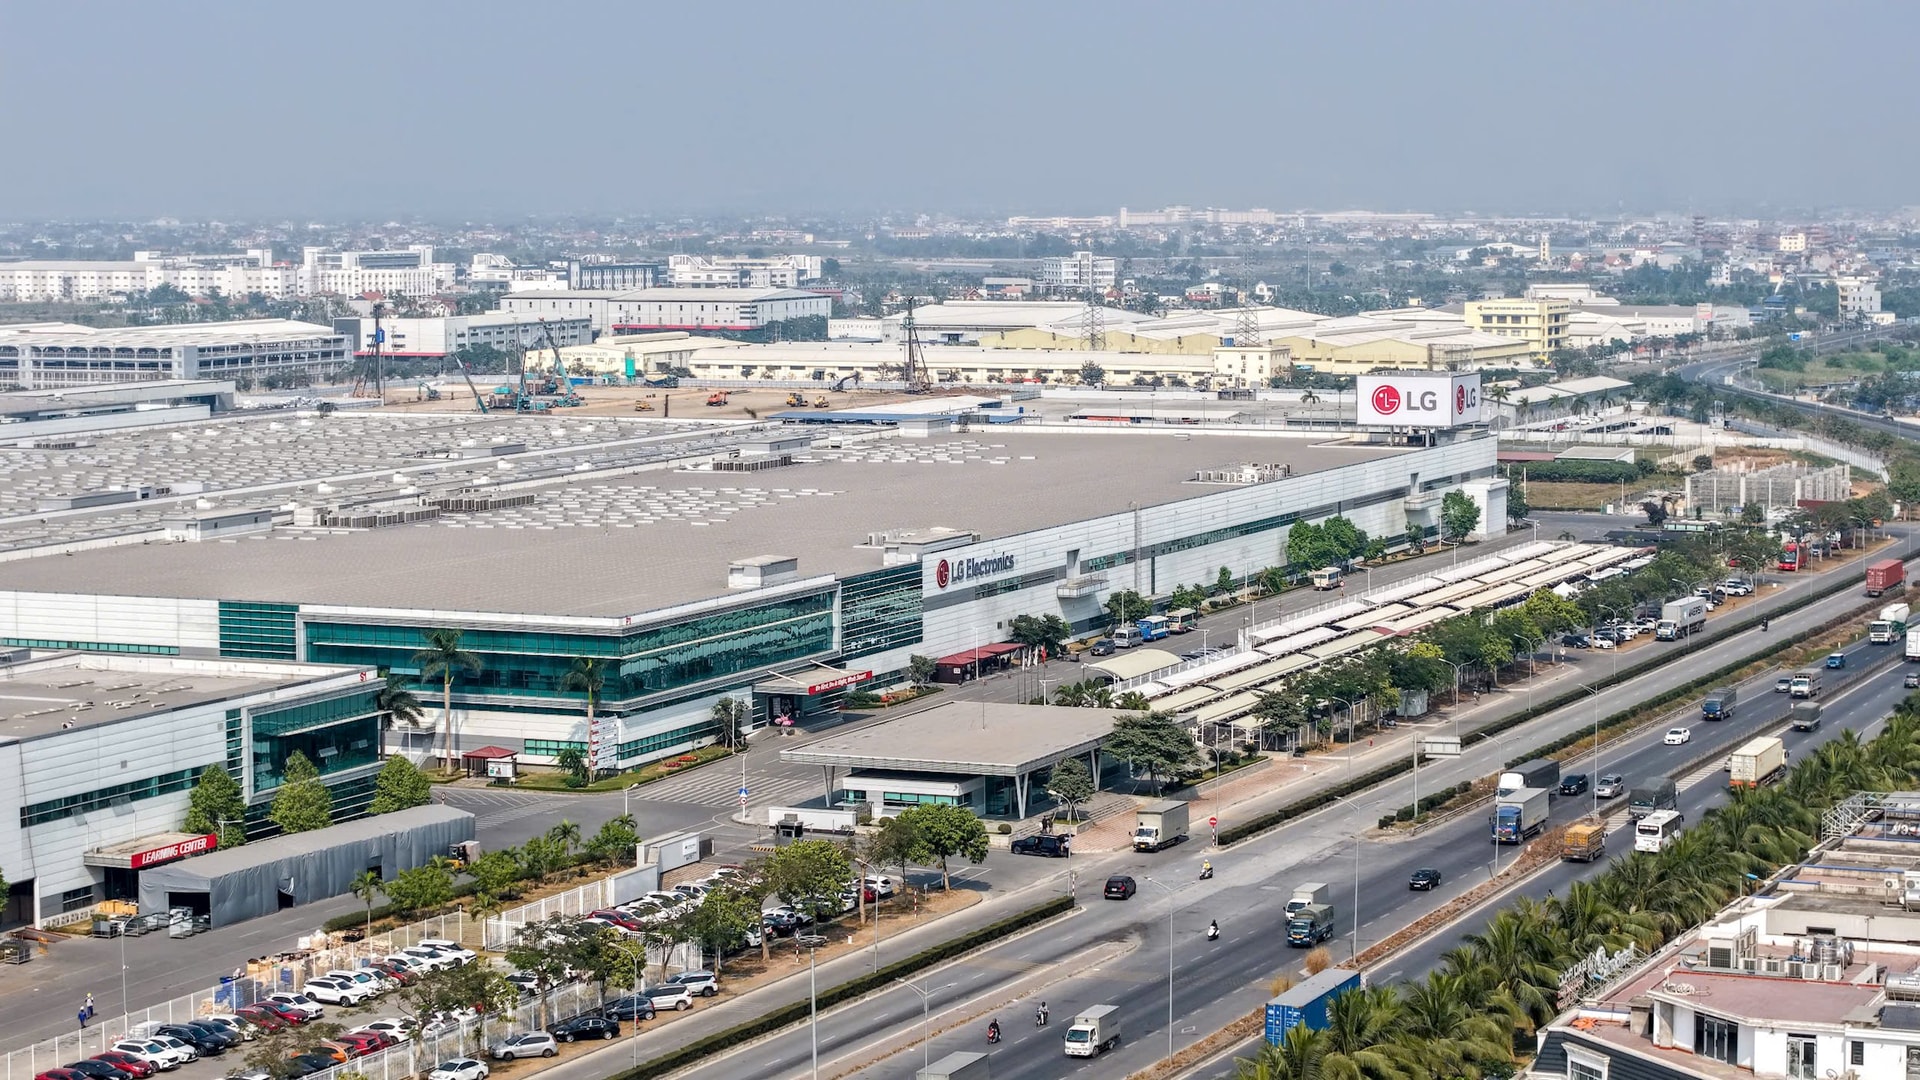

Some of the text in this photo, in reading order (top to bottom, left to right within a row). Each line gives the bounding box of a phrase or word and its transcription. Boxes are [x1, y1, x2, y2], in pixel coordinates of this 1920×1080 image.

[1406, 391, 1437, 411] LG
[1465, 387, 1476, 409] LG
[951, 551, 1015, 582] LG Electronics
[141, 837, 208, 865] LEARNING CENTER
